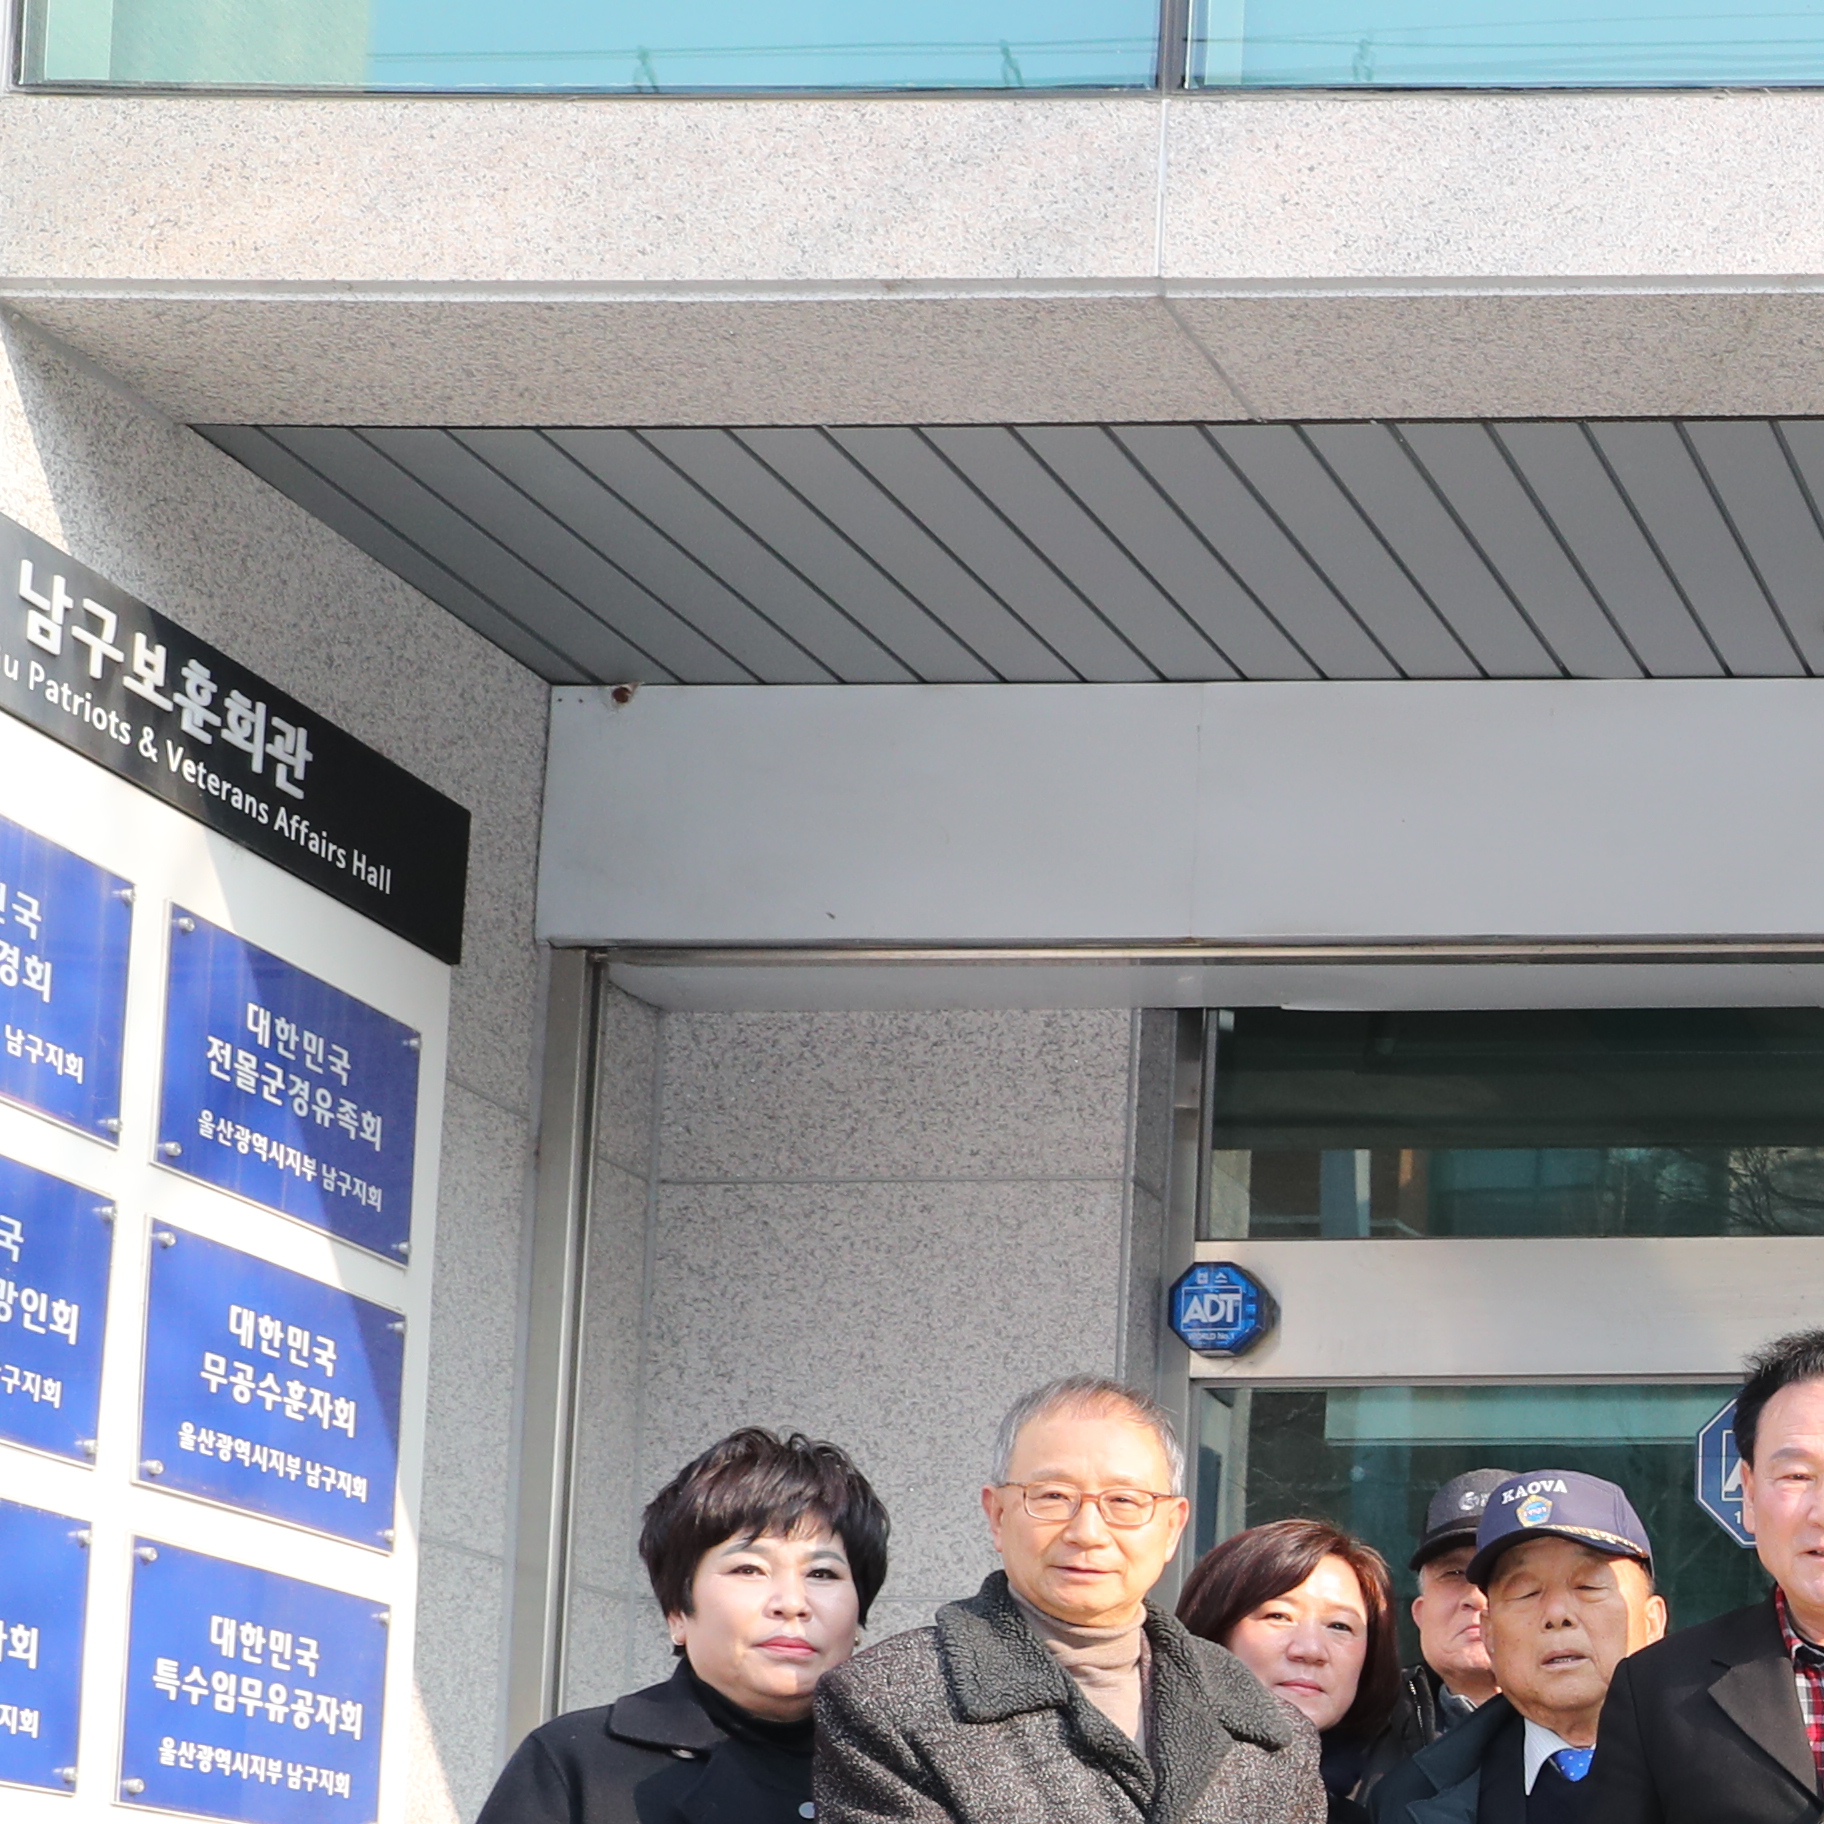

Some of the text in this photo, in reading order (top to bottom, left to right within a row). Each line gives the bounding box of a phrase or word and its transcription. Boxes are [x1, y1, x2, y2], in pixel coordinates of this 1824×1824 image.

[17, 558, 314, 801] 남구보훈회관
[28, 660, 132, 746] Patriots
[138, 726, 159, 764] &
[166, 738, 270, 826] Veterans
[273, 804, 347, 870] Affairs
[352, 849, 392, 896] Hall
[4, 1024, 84, 1085] 남구지회
[246, 1002, 352, 1086] 대한민국
[205, 1035, 383, 1152] 전몰군경유족회
[197, 1108, 383, 1212] 울산광역시지부 남구지회
[228, 1304, 339, 1378] 대한민국
[1182, 1293, 1242, 1324] ADT
[0, 1363, 62, 1409] 구지회
[200, 1350, 357, 1439] 무공수훈자회
[177, 1419, 369, 1504] 울산광역시지부 남구지회
[1501, 1478, 1569, 1506] KAOVA
[209, 1614, 320, 1678] 대한민국
[152, 1656, 364, 1741] 특수임무유공자회
[158, 1735, 352, 1799] 울산광역시지부 남구지회
